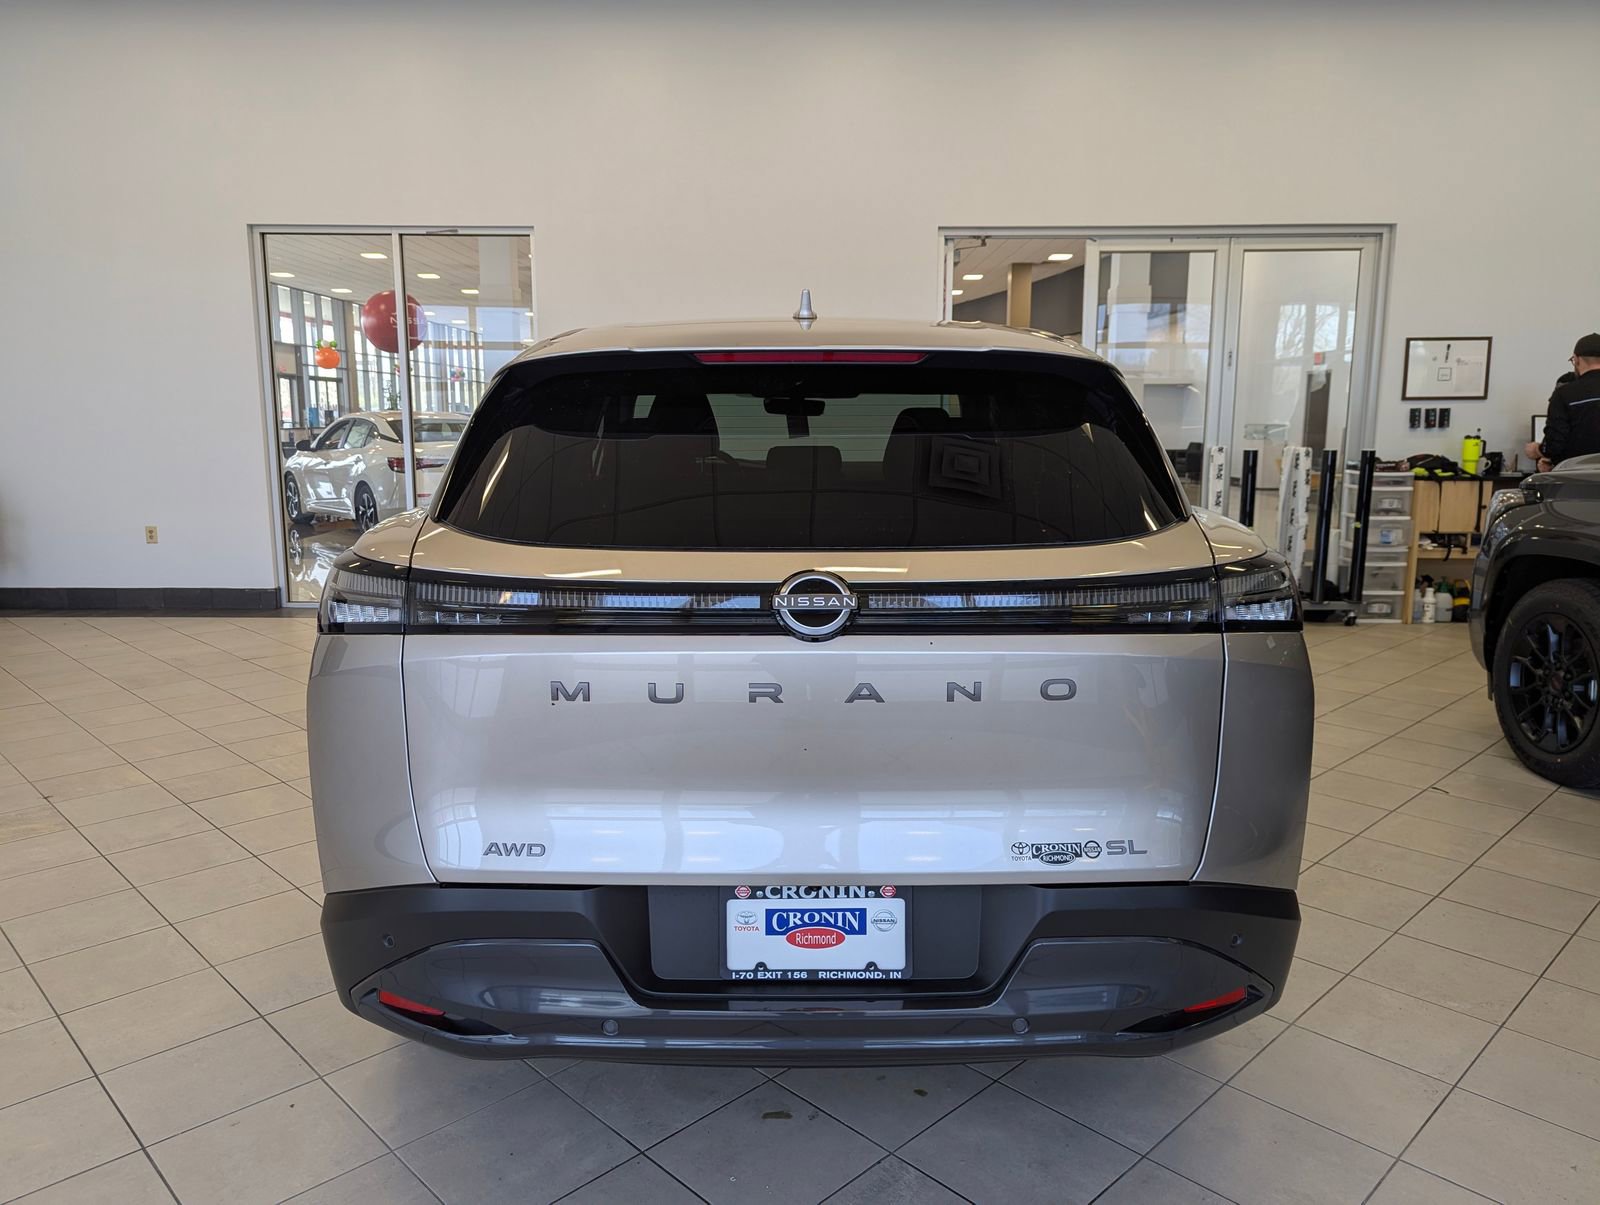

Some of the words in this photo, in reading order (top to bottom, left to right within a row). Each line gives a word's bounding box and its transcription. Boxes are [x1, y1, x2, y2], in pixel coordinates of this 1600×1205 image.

[775, 596, 856, 607] NISSAN
[550, 678, 1078, 704] MURANO
[482, 841, 546, 857] AWD
[1032, 843, 1081, 856] CRONIN
[1106, 839, 1148, 856] SL
[772, 911, 860, 932] CRONIN
[795, 932, 837, 945] Richmond
[732, 971, 754, 979] I-70
[757, 971, 783, 979] EXIT
[787, 971, 808, 979] 156
[889, 971, 902, 979] IN
